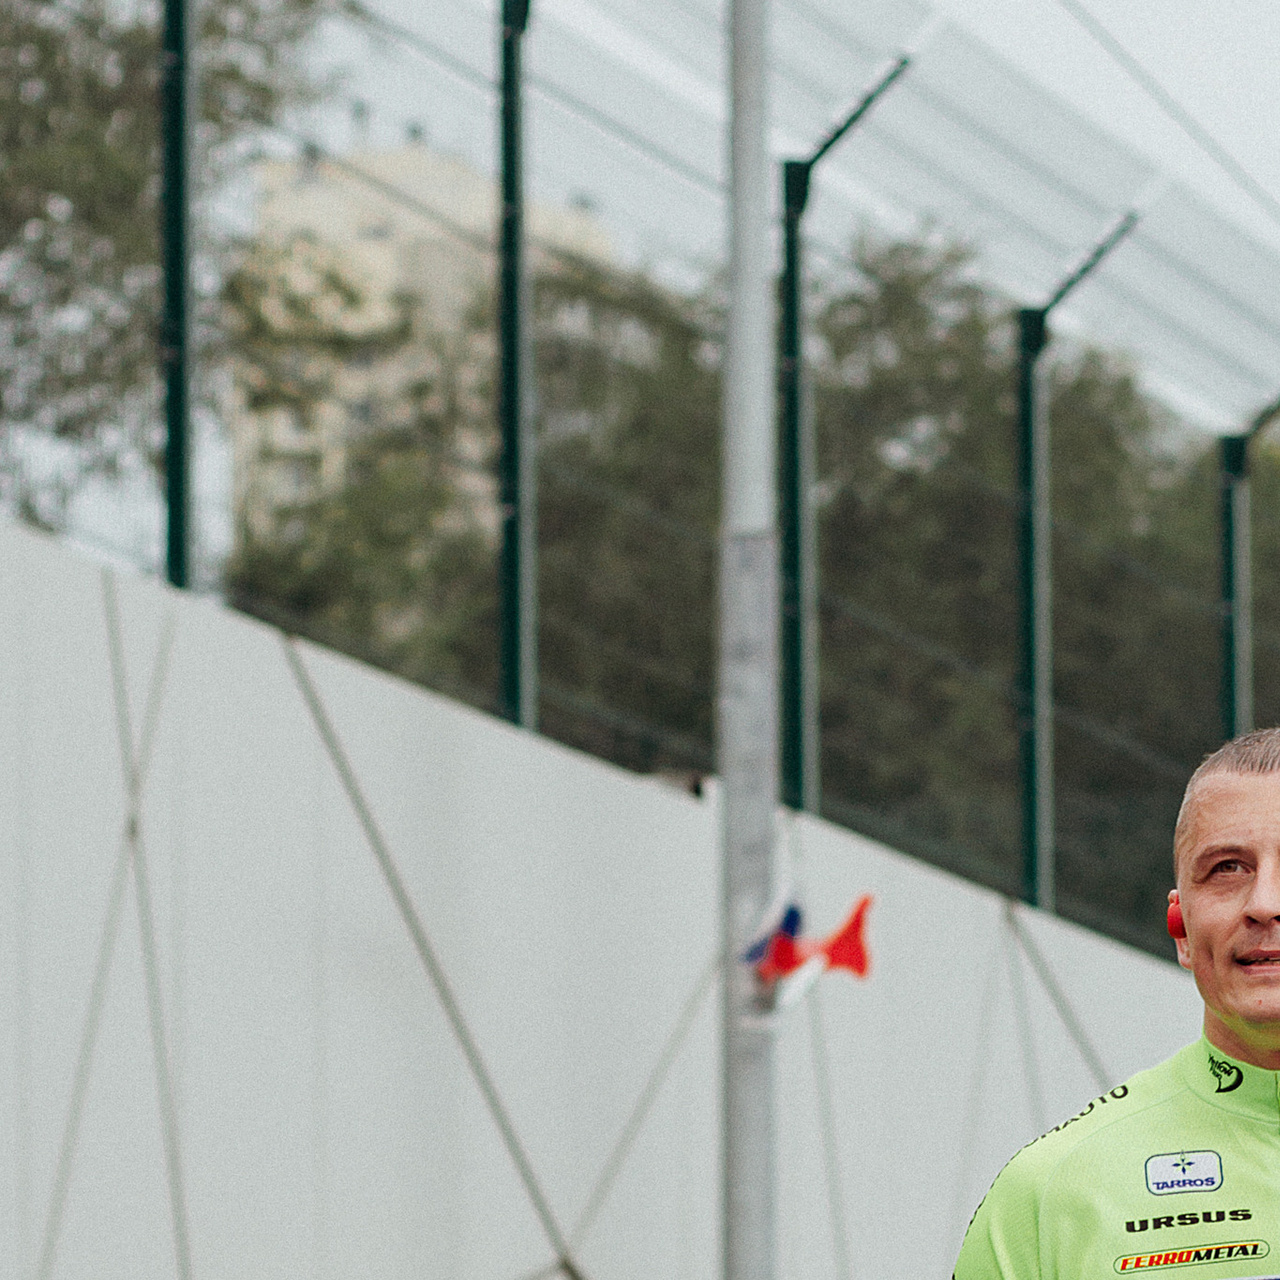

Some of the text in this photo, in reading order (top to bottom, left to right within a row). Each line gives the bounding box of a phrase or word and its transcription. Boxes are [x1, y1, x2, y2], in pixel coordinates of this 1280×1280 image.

[1152, 1177, 1216, 1190] TARROS
[1125, 1209, 1252, 1233] URSUS
[1120, 1243, 1264, 1271] FERROMETAL
